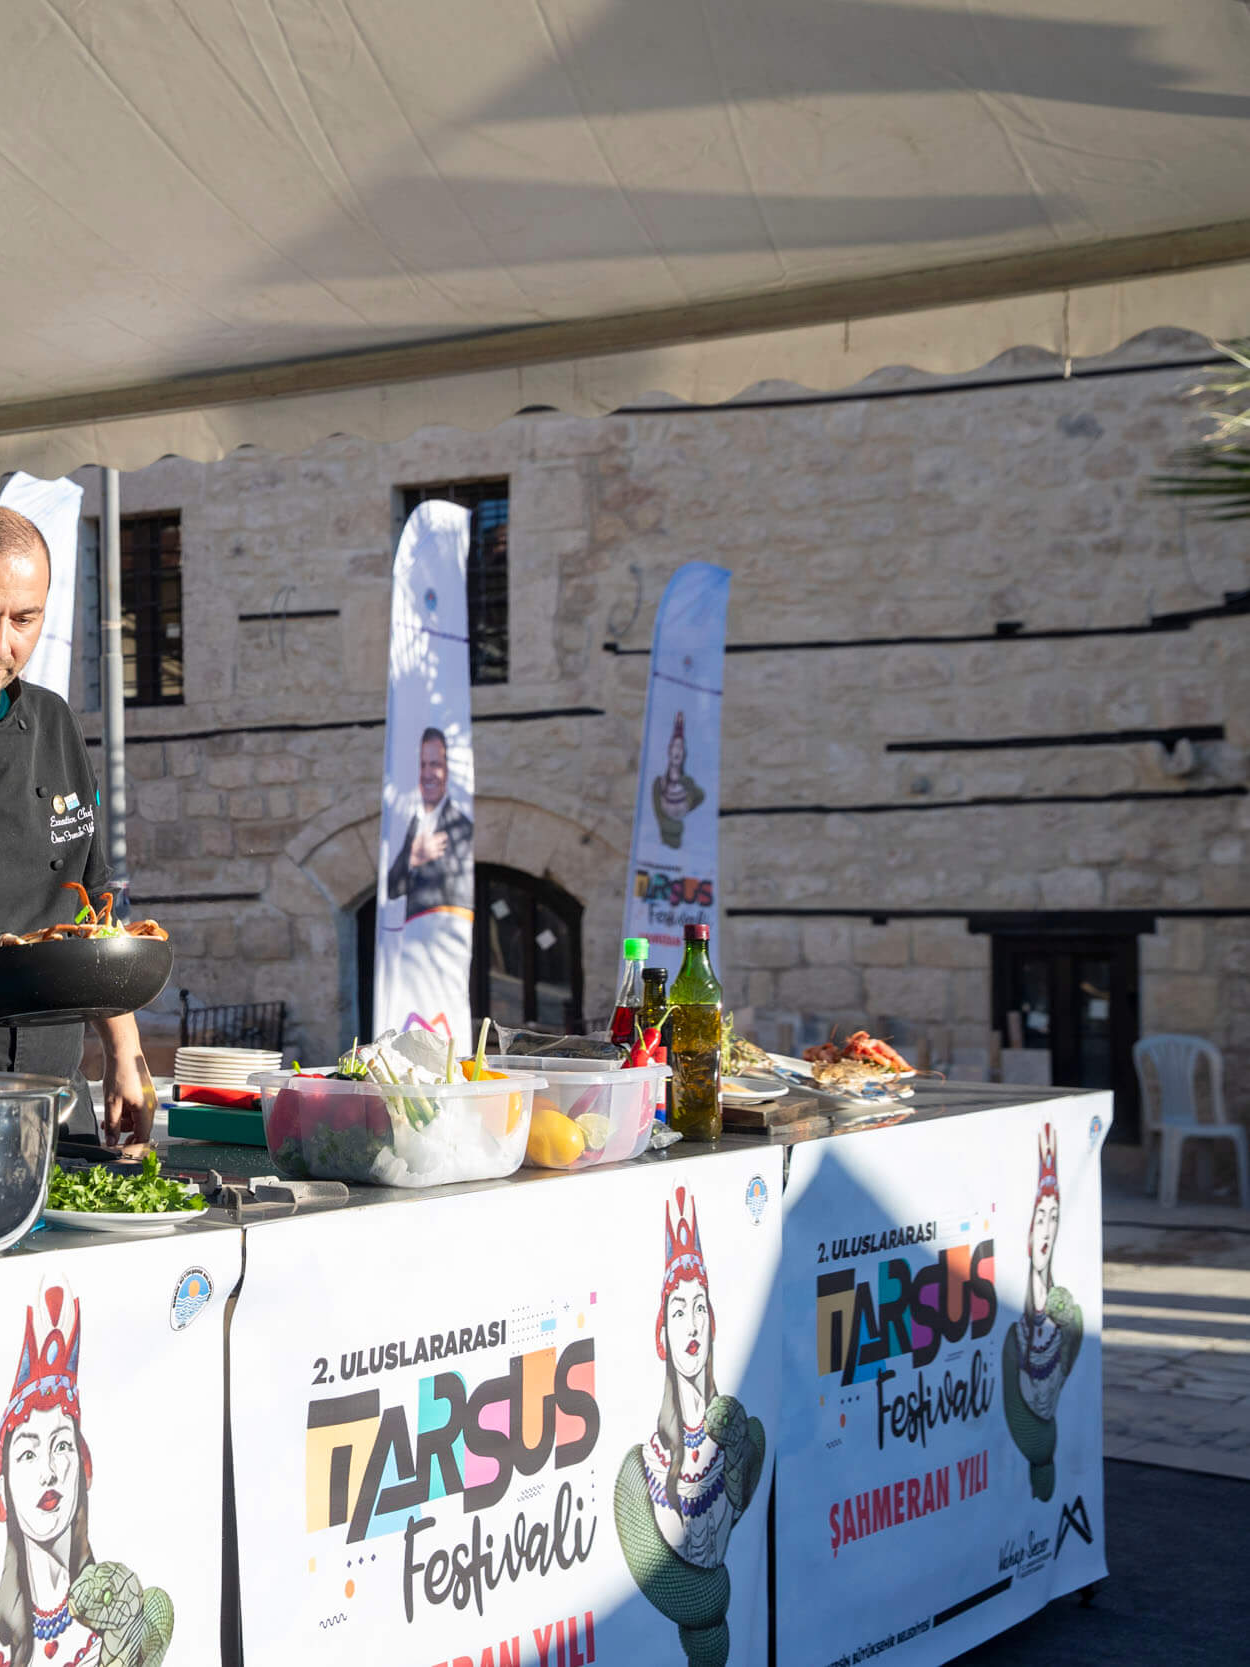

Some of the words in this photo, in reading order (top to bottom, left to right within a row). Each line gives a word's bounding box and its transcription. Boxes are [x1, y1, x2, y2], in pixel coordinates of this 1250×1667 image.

[817, 1242, 829, 1264] 2.
[832, 1221, 937, 1260] ULUSLARARASI
[311, 1358, 335, 1386] 2.
[340, 1319, 507, 1381] ULUSLARARASI
[816, 1238, 997, 1387] TARSUS
[306, 1337, 600, 1545] TARSUS
[876, 1350, 995, 1450] Festivali
[403, 1481, 597, 1624] Festivali
[829, 1466, 950, 1560] ŞAHMERAN
[957, 1449, 989, 1501] YILI
